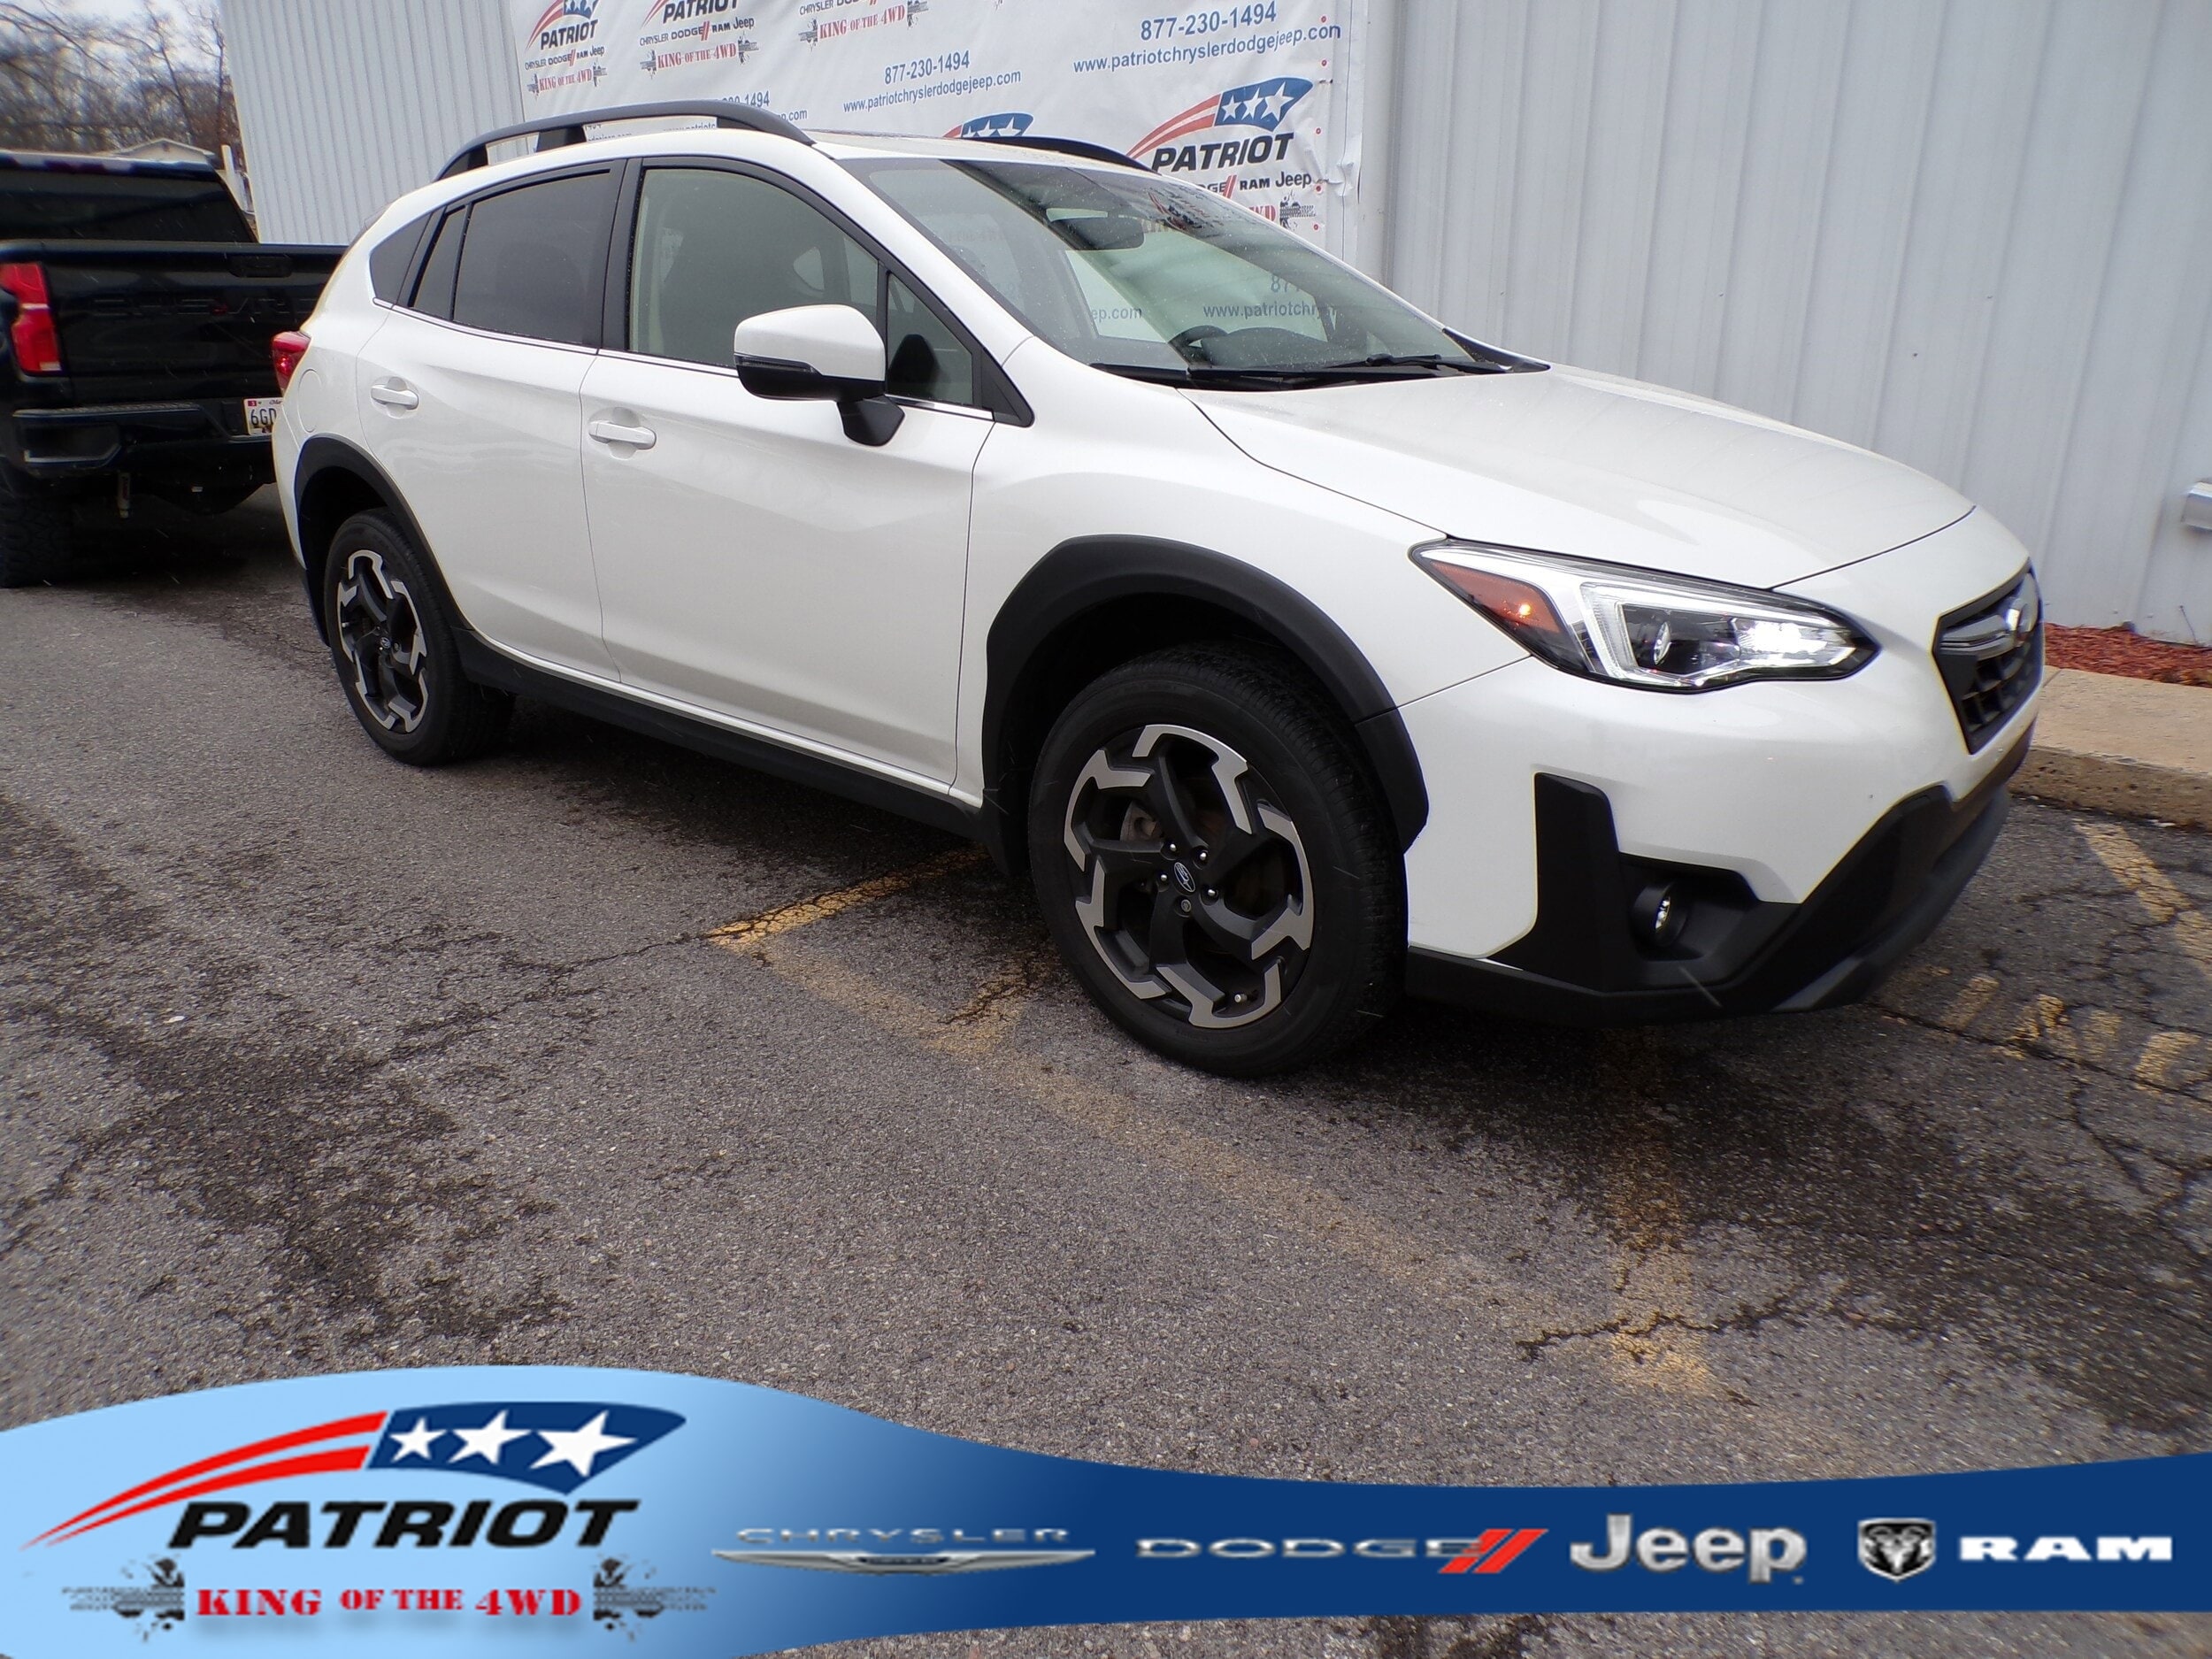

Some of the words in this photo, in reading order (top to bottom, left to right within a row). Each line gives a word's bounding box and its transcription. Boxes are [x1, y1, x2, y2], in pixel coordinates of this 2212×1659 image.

[541, 19, 599, 50] PATRIOT
[672, 27, 703, 40] DODGE
[712, 22, 731, 33] RAM
[733, 17, 755, 30] Jeep
[819, 19, 847, 39] KING
[850, 18, 861, 31] OF
[862, 14, 878, 28] THE
[880, 4, 905, 25] 4WD
[1141, 1, 1277, 41] 877-230-1494
[590, 45, 605, 58] Jeep
[657, 51, 682, 69] KING
[685, 53, 695, 63] OF
[696, 50, 710, 60] THE
[713, 43, 737, 59] 4WD
[885, 50, 970, 85] 877-230-1494
[843, 71, 1022, 112] www.patriotchryslerdodgejeep.com
[1151, 132, 1294, 173] PATRIOT
[1240, 178, 1271, 190] RAM
[1276, 172, 1312, 188] Jeep
